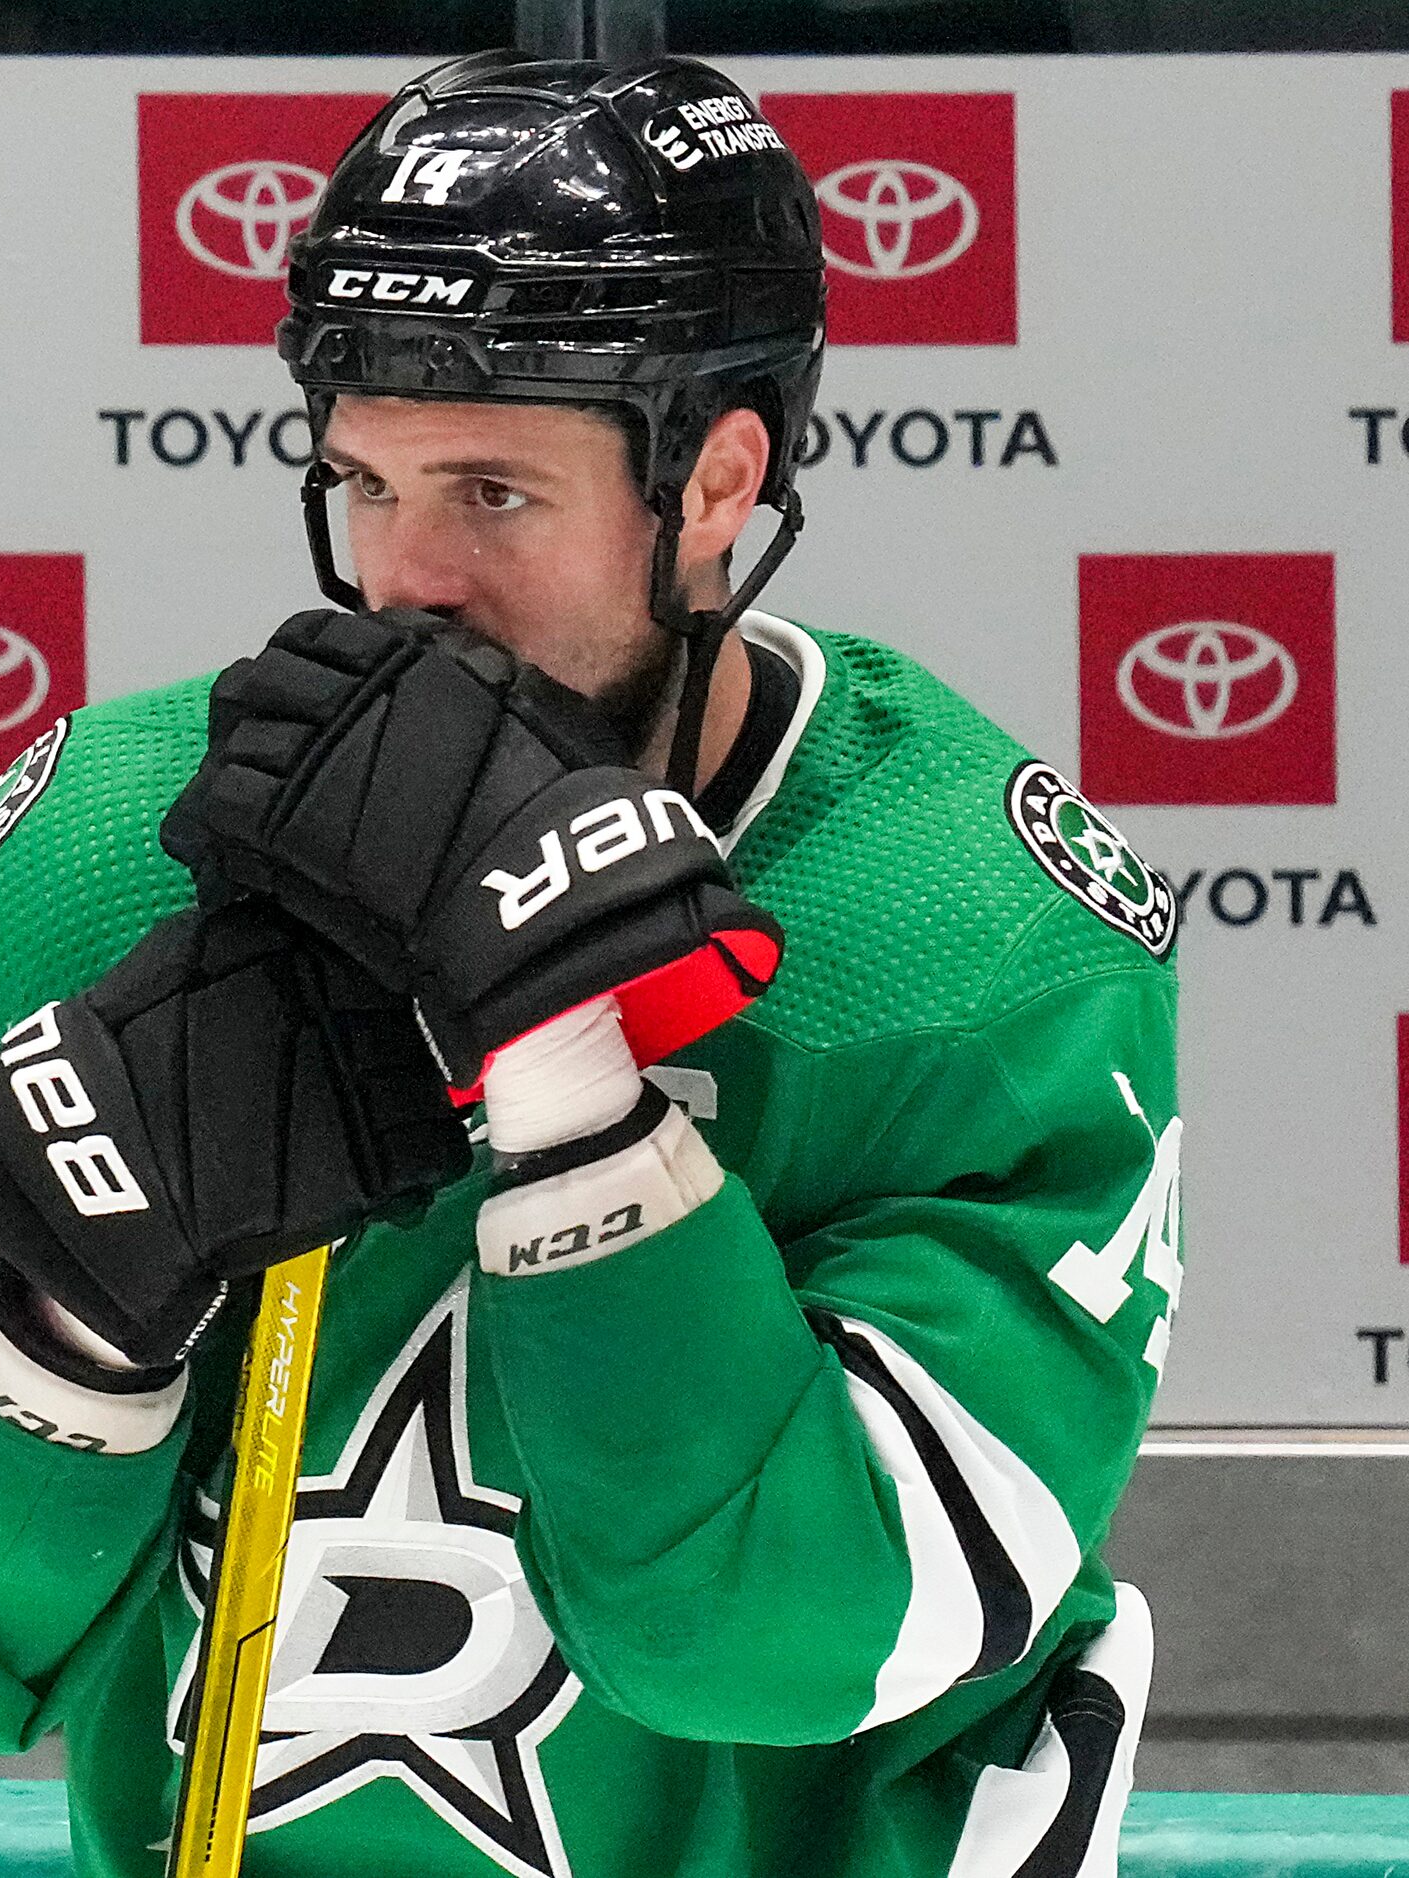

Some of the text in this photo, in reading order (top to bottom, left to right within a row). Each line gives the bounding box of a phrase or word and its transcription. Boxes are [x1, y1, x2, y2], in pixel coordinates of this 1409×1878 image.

[678, 95, 752, 131] ENERGY
[698, 123, 787, 158] TRANSFER
[381, 144, 474, 206] 14
[328, 265, 474, 306] CCM
[508, 1202, 654, 1273] CCM
[253, 1281, 302, 1497] HYPERLITE
